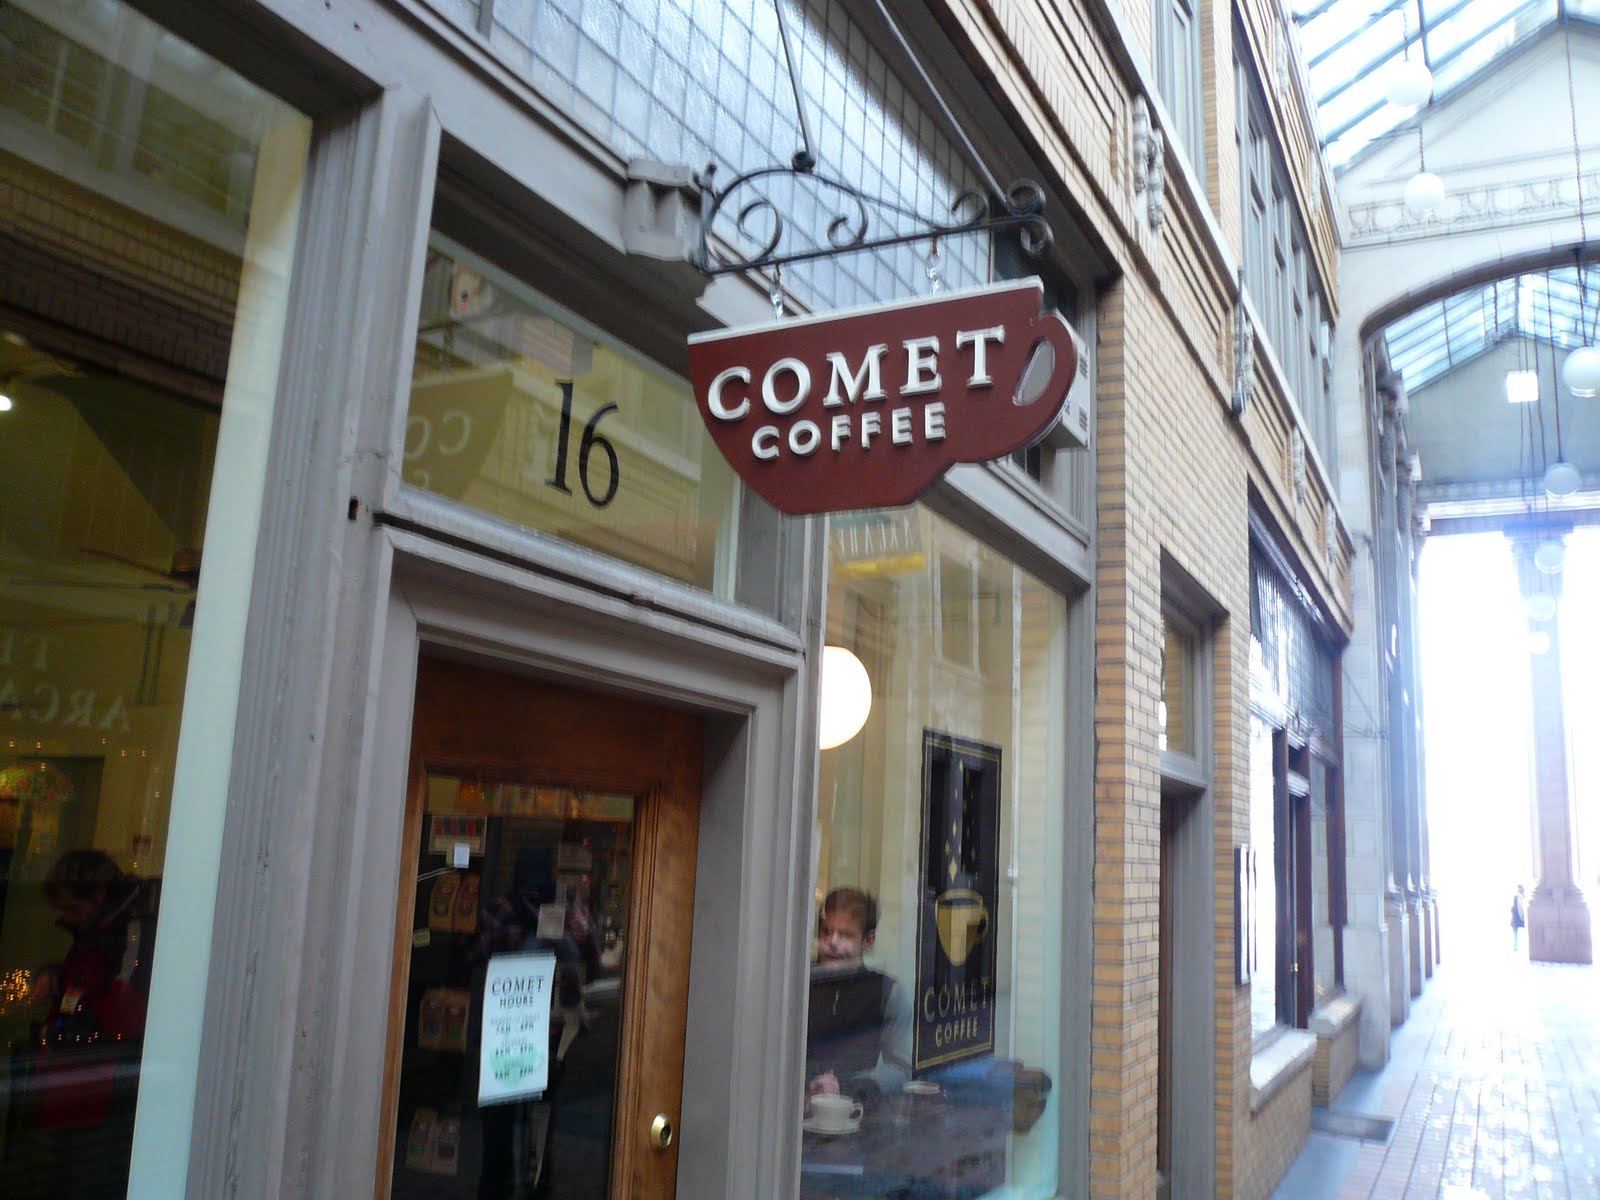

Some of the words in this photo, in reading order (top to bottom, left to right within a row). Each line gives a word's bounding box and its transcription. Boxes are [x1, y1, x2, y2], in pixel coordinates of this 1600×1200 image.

[707, 324, 1006, 421] COMET
[544, 378, 620, 509] 16
[751, 401, 946, 461] COFFEE
[492, 975, 544, 997] COMET
[499, 993, 534, 1009] HOURS
[923, 975, 991, 1023] COMET
[935, 1015, 979, 1048] COFFEE
